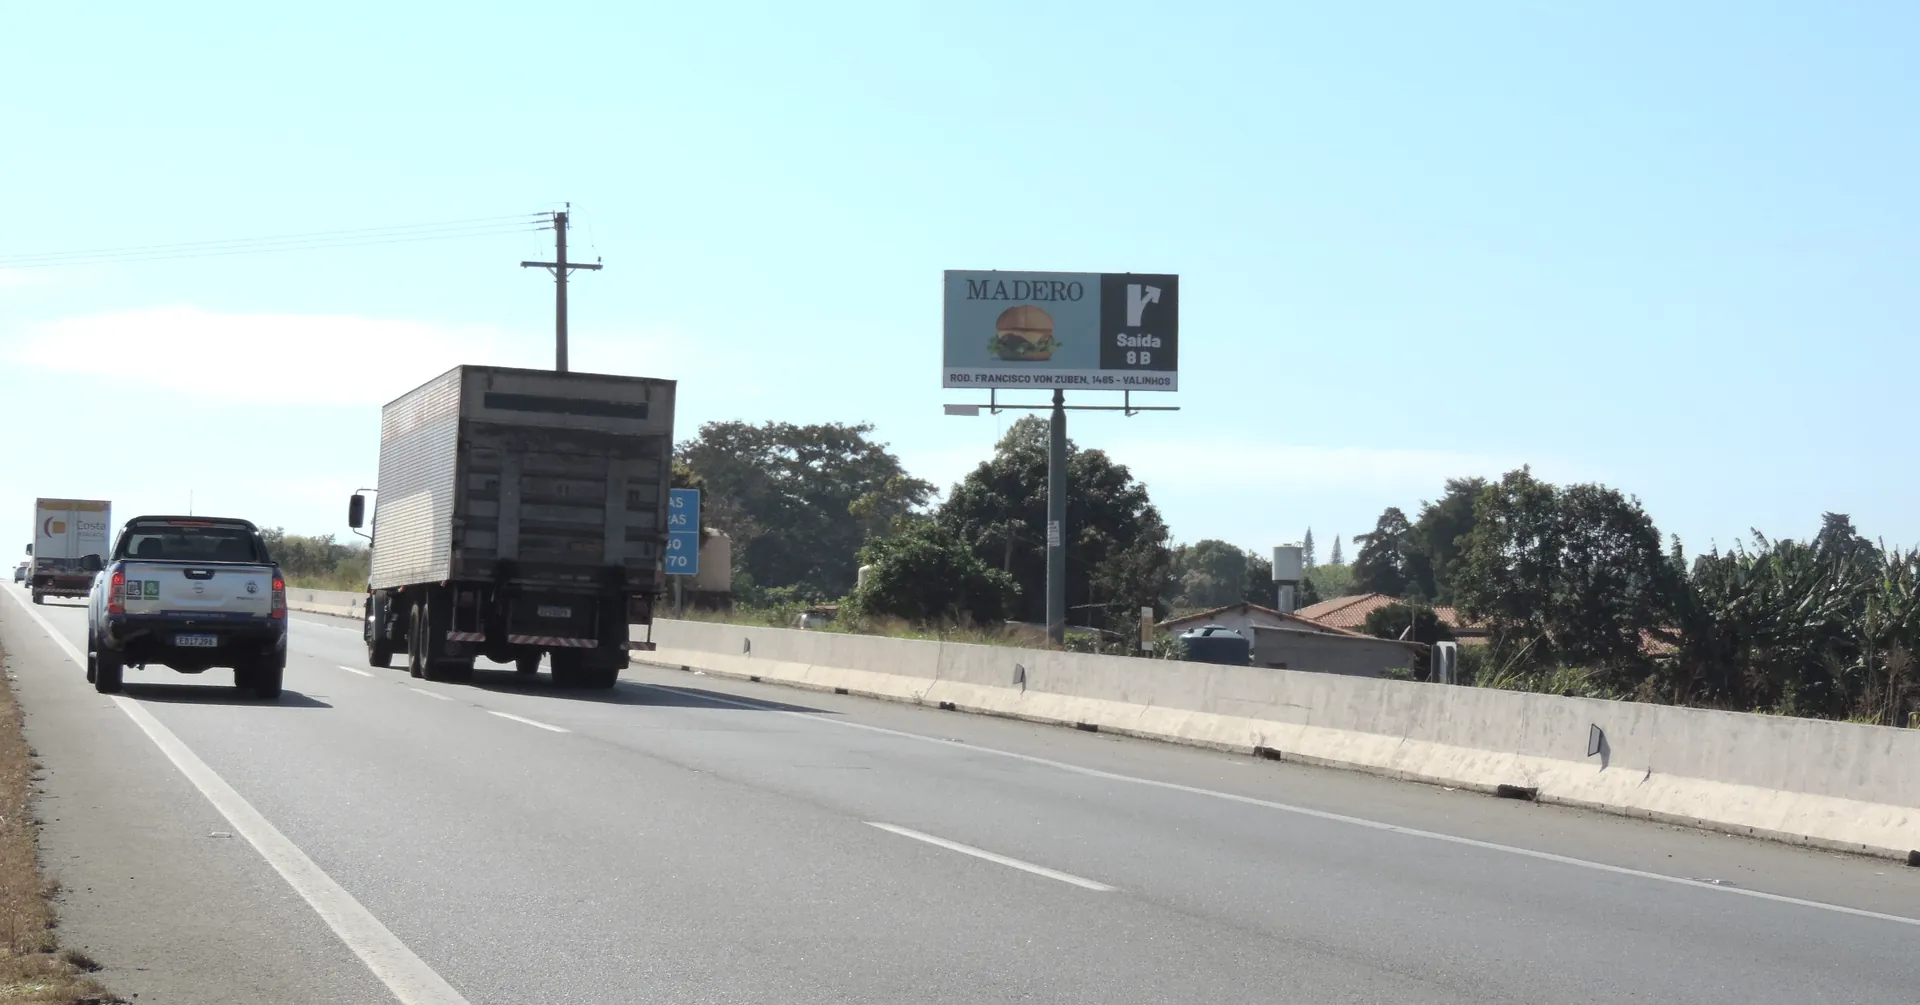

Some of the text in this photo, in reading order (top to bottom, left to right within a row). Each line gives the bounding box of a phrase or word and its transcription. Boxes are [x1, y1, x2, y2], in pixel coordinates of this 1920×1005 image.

[966, 279, 1084, 302] MADERO
[1126, 351, 1151, 365] 8 B
[950, 373, 972, 382] ROD.
[975, 374, 1031, 383] FRANCISCO
[1033, 375, 1053, 383] VON
[1122, 376, 1171, 386] VALINHOS
[76, 520, 106, 531] Costa
